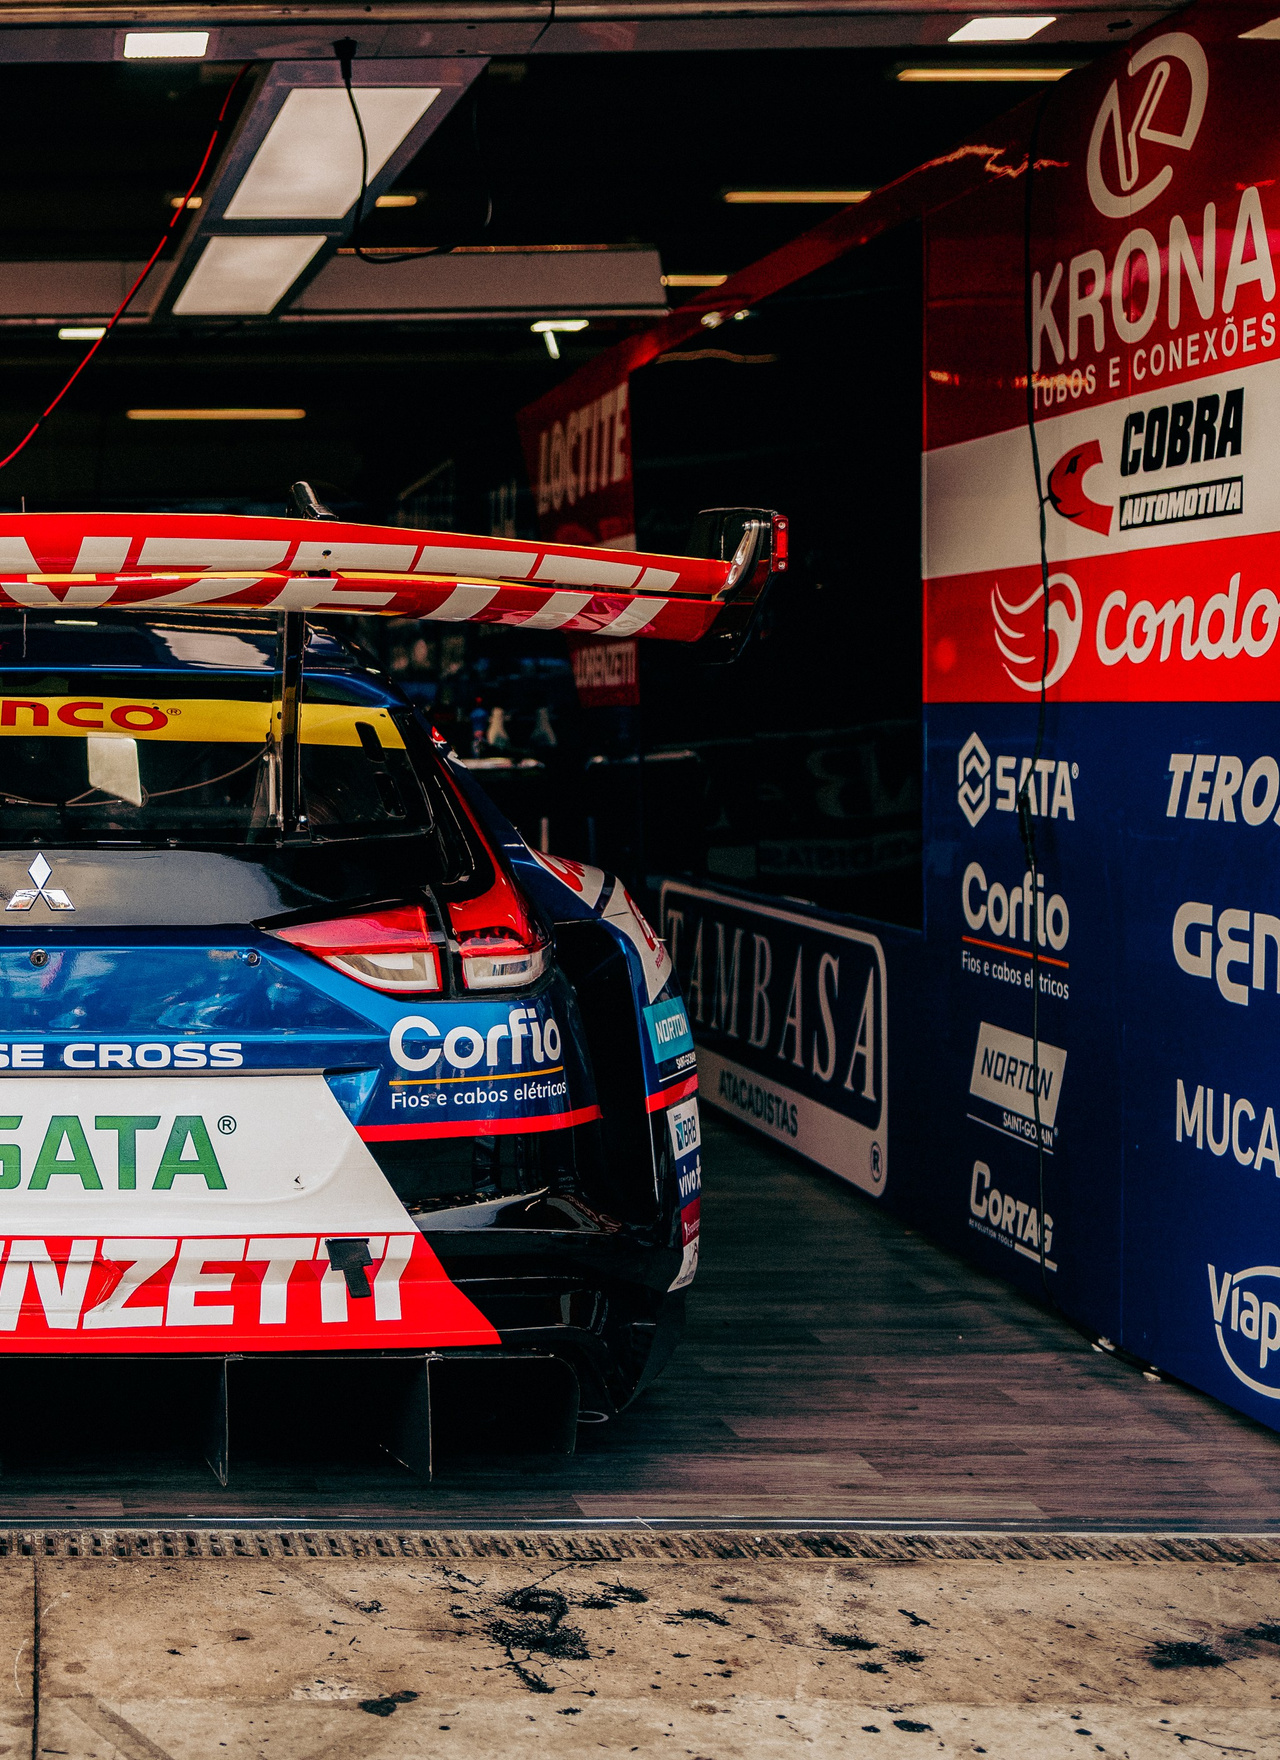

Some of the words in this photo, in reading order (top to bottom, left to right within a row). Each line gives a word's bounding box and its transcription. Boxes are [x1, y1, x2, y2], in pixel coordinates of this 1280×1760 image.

[1032, 186, 1276, 372] KRONA
[1033, 364, 1096, 410] TUBOS
[1109, 357, 1121, 388] E
[1133, 312, 1276, 381] CONEXÕES
[536, 380, 629, 516] LOCTITE
[1120, 387, 1245, 477] COBRA
[1121, 481, 1242, 527] AUTOMOTIVA
[1166, 753, 1280, 827] TERO
[962, 861, 1070, 951] Corfio
[667, 908, 877, 1102] TAMBASA
[962, 951, 981, 975] Fios
[984, 961, 990, 977] e
[992, 963, 1022, 986] cabos
[1024, 968, 1069, 1000] eltricos
[63, 1042, 244, 1068] CROSS
[389, 1008, 562, 1072] Corfio
[655, 1012, 688, 1045] NORTON
[391, 1092, 429, 1109] Fios
[436, 1094, 447, 1106] e
[454, 1087, 508, 1104] cabos
[513, 1080, 567, 1101] elétricos
[719, 1070, 798, 1138] ATACADISTAS
[981, 1047, 1053, 1101] NORTON
[683, 1115, 697, 1148] BRB
[1003, 1111, 1053, 1148] SAINT-GOAIN
[1176, 1078, 1280, 1179] MUCA
[679, 1165, 696, 1198] vivo
[970, 1159, 1054, 1253] CORTAG
